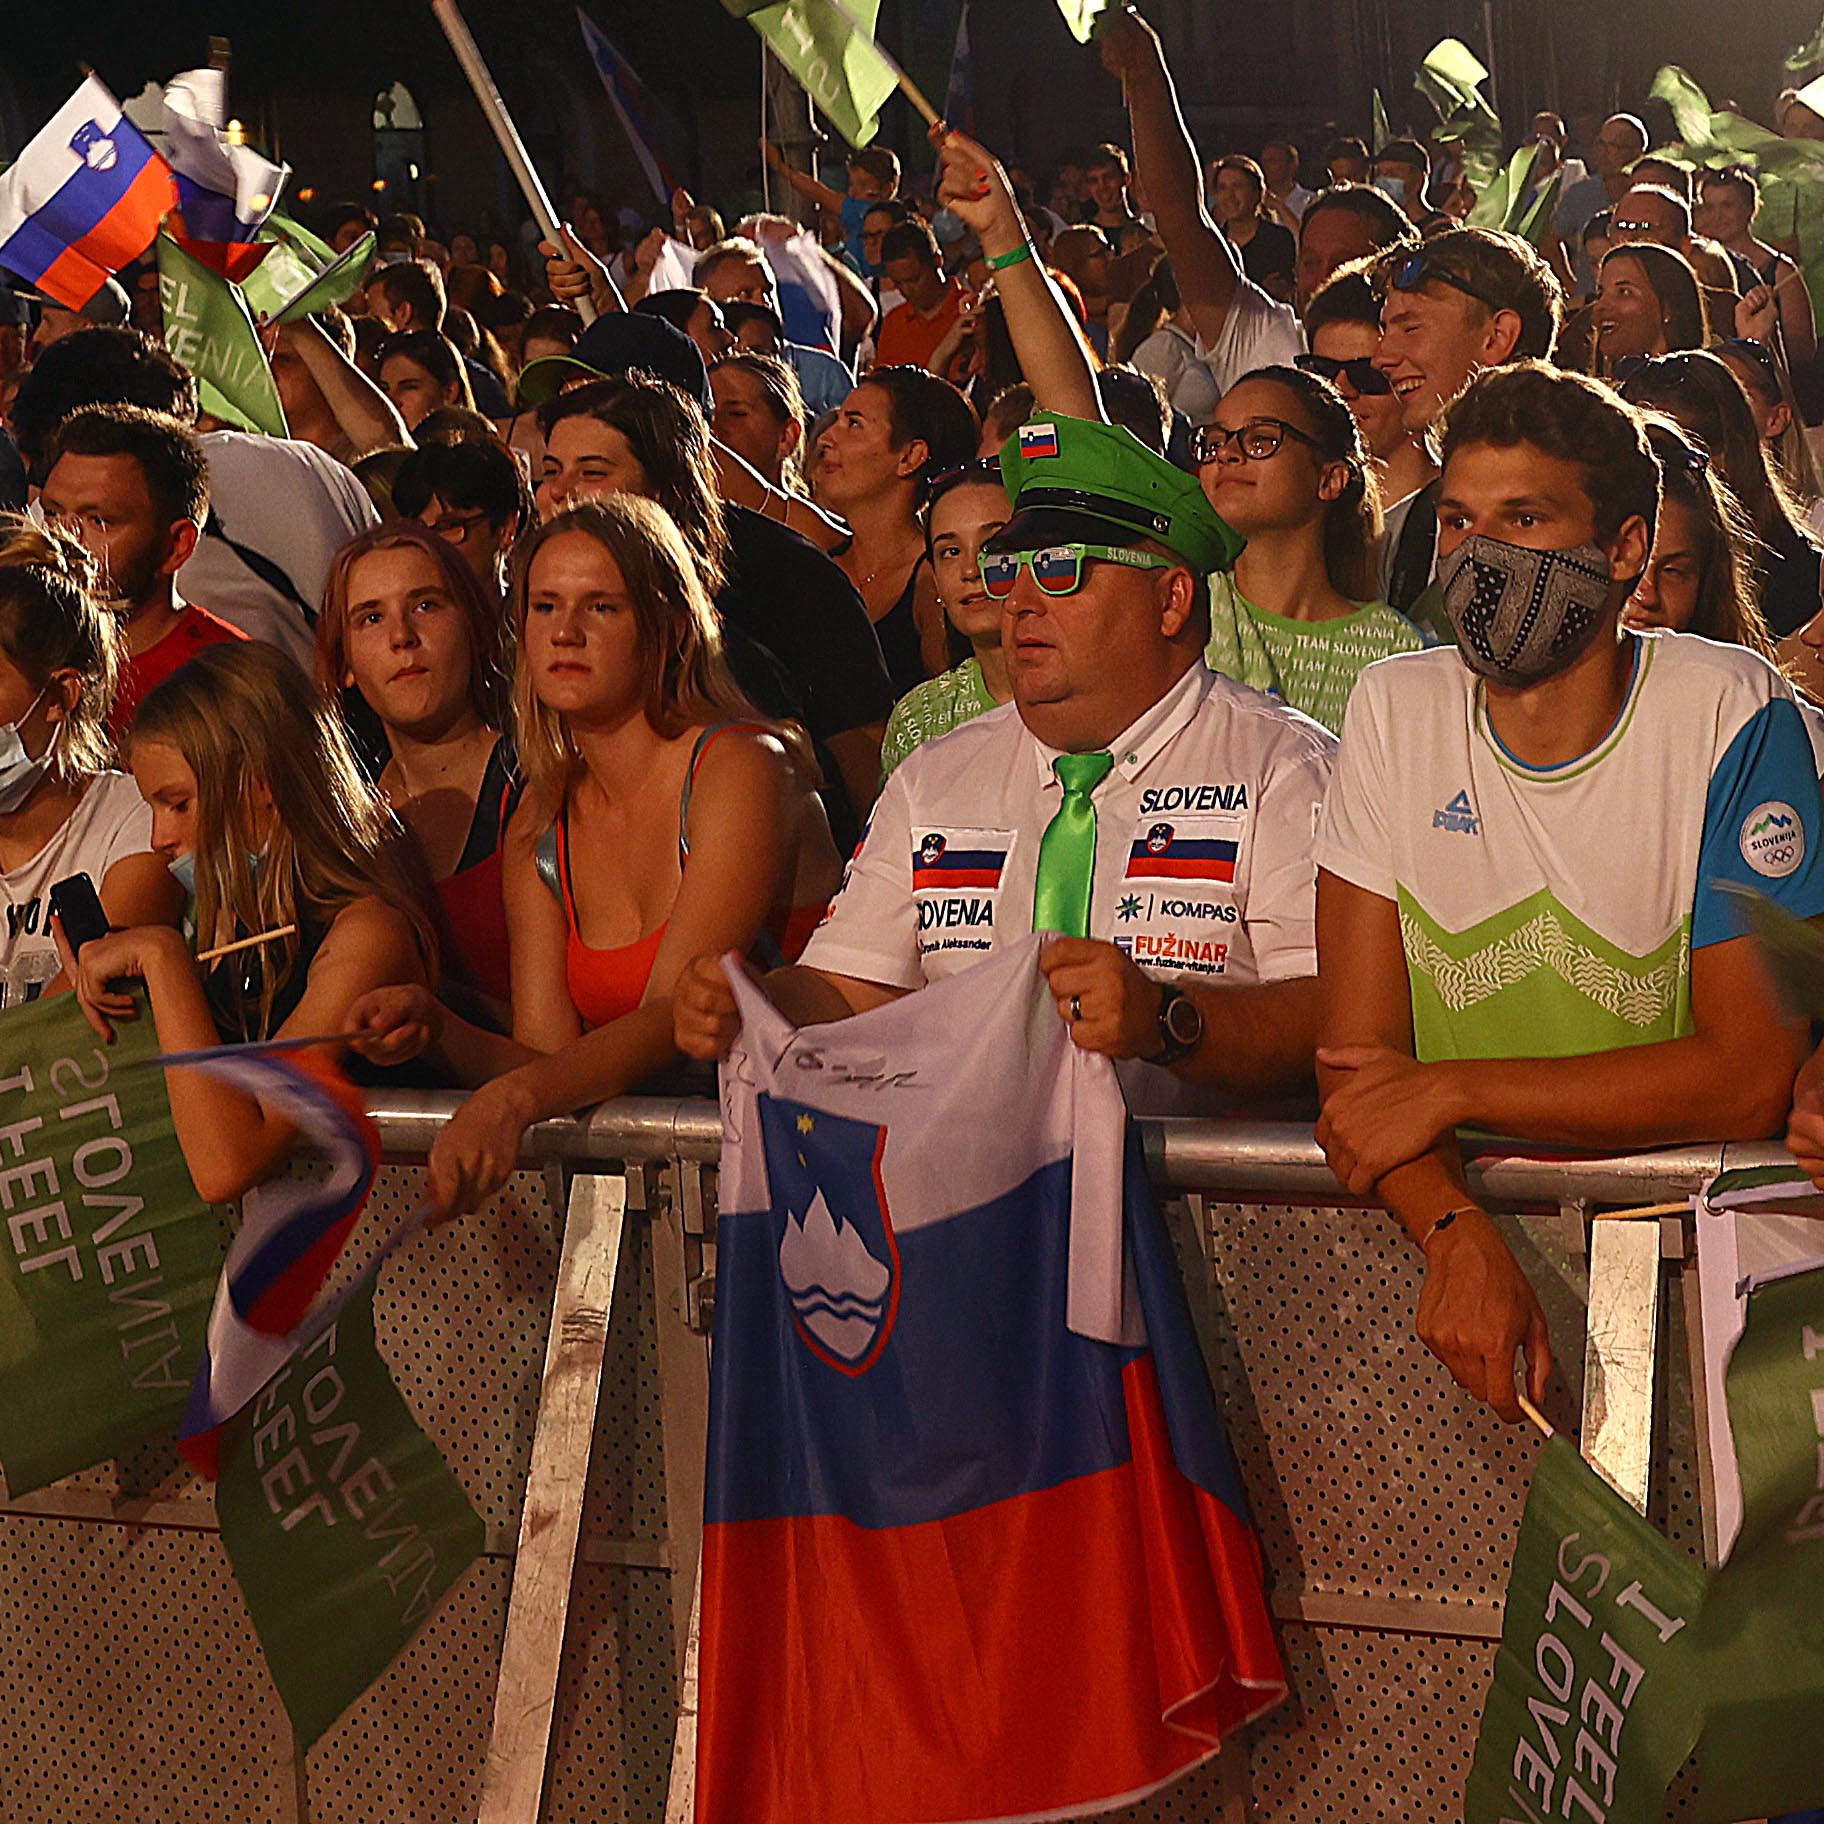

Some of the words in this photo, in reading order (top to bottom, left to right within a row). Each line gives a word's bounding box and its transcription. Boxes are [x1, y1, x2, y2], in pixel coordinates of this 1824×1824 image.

[158, 273, 199, 323] EL
[1107, 546, 1152, 568] SLOVENIA
[1295, 633, 1330, 652] TEAM
[1139, 783, 1249, 815] SLOVENIA
[1750, 829, 1797, 852] SLOVENIJA
[1160, 899, 1237, 923] KOMPAS
[940, 937, 993, 952] Aleksander
[1134, 932, 1229, 963] FUŽINAR
[1615, 1579, 1688, 1644] I
[1560, 1631, 1646, 1824] FEEL
